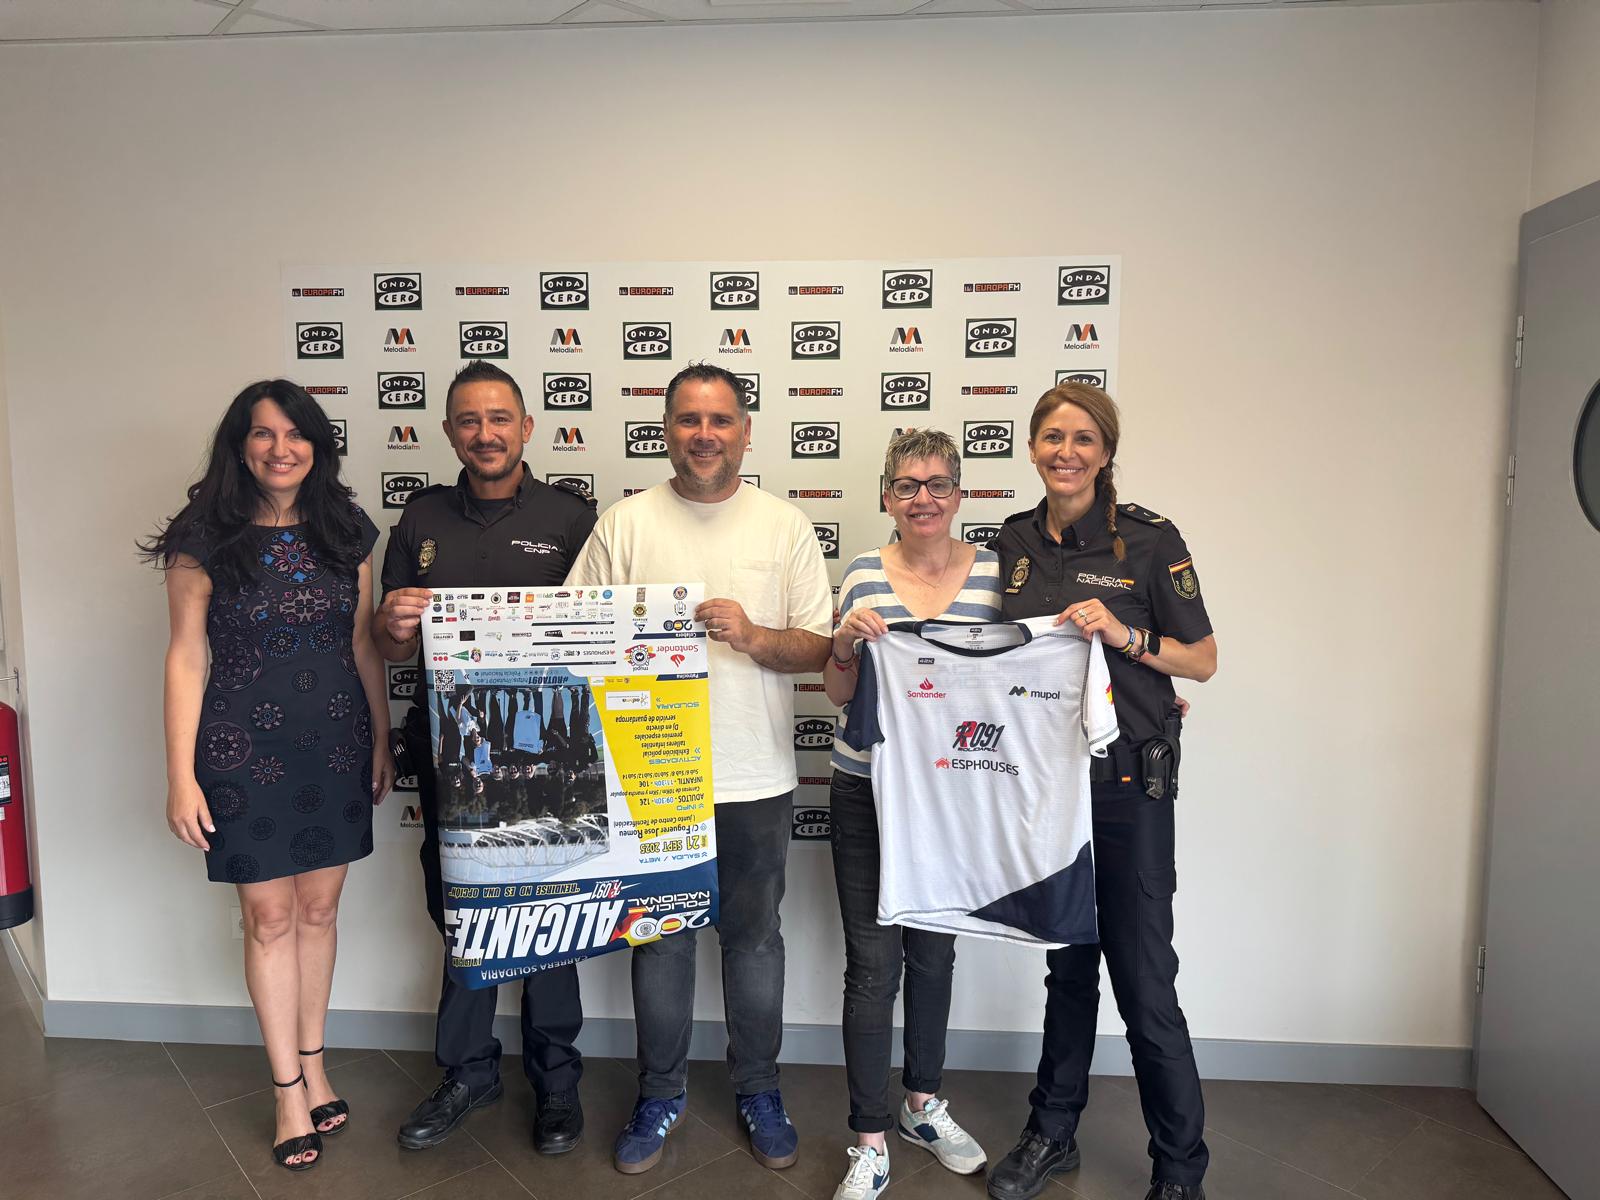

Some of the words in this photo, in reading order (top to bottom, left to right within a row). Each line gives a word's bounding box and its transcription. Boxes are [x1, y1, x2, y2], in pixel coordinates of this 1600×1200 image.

[890, 278, 924, 287] ONDA
[1066, 274, 1101, 282] ONDA
[381, 280, 414, 289] ONDA
[547, 280, 581, 288] ONDA
[718, 280, 751, 288] ONDA
[976, 284, 1020, 292] EUROPAFM
[800, 286, 843, 294] EUROPAFM
[1068, 286, 1101, 298] CERO
[383, 294, 415, 303] CERO
[550, 294, 581, 304] CERO
[720, 294, 751, 303] CERO
[892, 290, 924, 301] CERO
[304, 330, 336, 338] ONDA
[467, 330, 501, 338] ONDA
[630, 330, 663, 338] ONDA
[799, 330, 832, 338] ONDA
[974, 328, 1008, 336] ONDA
[306, 342, 336, 352] CERO
[469, 342, 500, 352] CERO
[633, 343, 664, 352] CERO
[801, 342, 832, 352] CERO
[975, 340, 1008, 350] CERO
[386, 380, 417, 388] ONDA
[551, 380, 584, 388] ONDA
[890, 380, 922, 388] ONDA
[972, 386, 1018, 394] EUROPAFM
[388, 392, 418, 402] CERO
[554, 394, 584, 403] CERO
[890, 392, 922, 402] CERO
[800, 430, 832, 438] ONDA
[972, 429, 1005, 437] ONDA
[634, 442, 666, 452] CERO
[800, 442, 832, 452] CERO
[973, 442, 1005, 451] CERO
[512, 540, 558, 550] POLICIA
[1078, 572, 1121, 583] POLICIA
[1076, 578, 1132, 590] NACIONAL
[656, 644, 698, 653] Santander
[528, 676, 568, 684] #RUTA091
[907, 690, 946, 699] Santander
[1030, 690, 1060, 701] mupol
[616, 714, 647, 723] guardarropa
[798, 724, 831, 732] ONDA
[800, 736, 831, 744] CERO
[642, 750, 662, 758] policial
[649, 756, 701, 764] ACTIVIDADES
[951, 758, 1019, 776] ESPHOUSES
[678, 776, 704, 784] INFANTIL
[678, 793, 704, 802] ADULTOS
[660, 824, 690, 834] Foguerer
[800, 824, 830, 834] CERO
[619, 829, 643, 839] Romeu
[662, 840, 682, 852] SEPT
[686, 835, 700, 850] 21
[640, 842, 660, 854] 2025
[484, 887, 500, 898] UNA
[504, 886, 516, 896] ES
[520, 885, 532, 896] NO
[628, 891, 710, 907] NACIONAL
[643, 900, 710, 914] POLICIA
[452, 900, 624, 959] ALICANTE
[540, 956, 588, 970] CARRERA
[480, 964, 538, 980] SOLIDARIA
